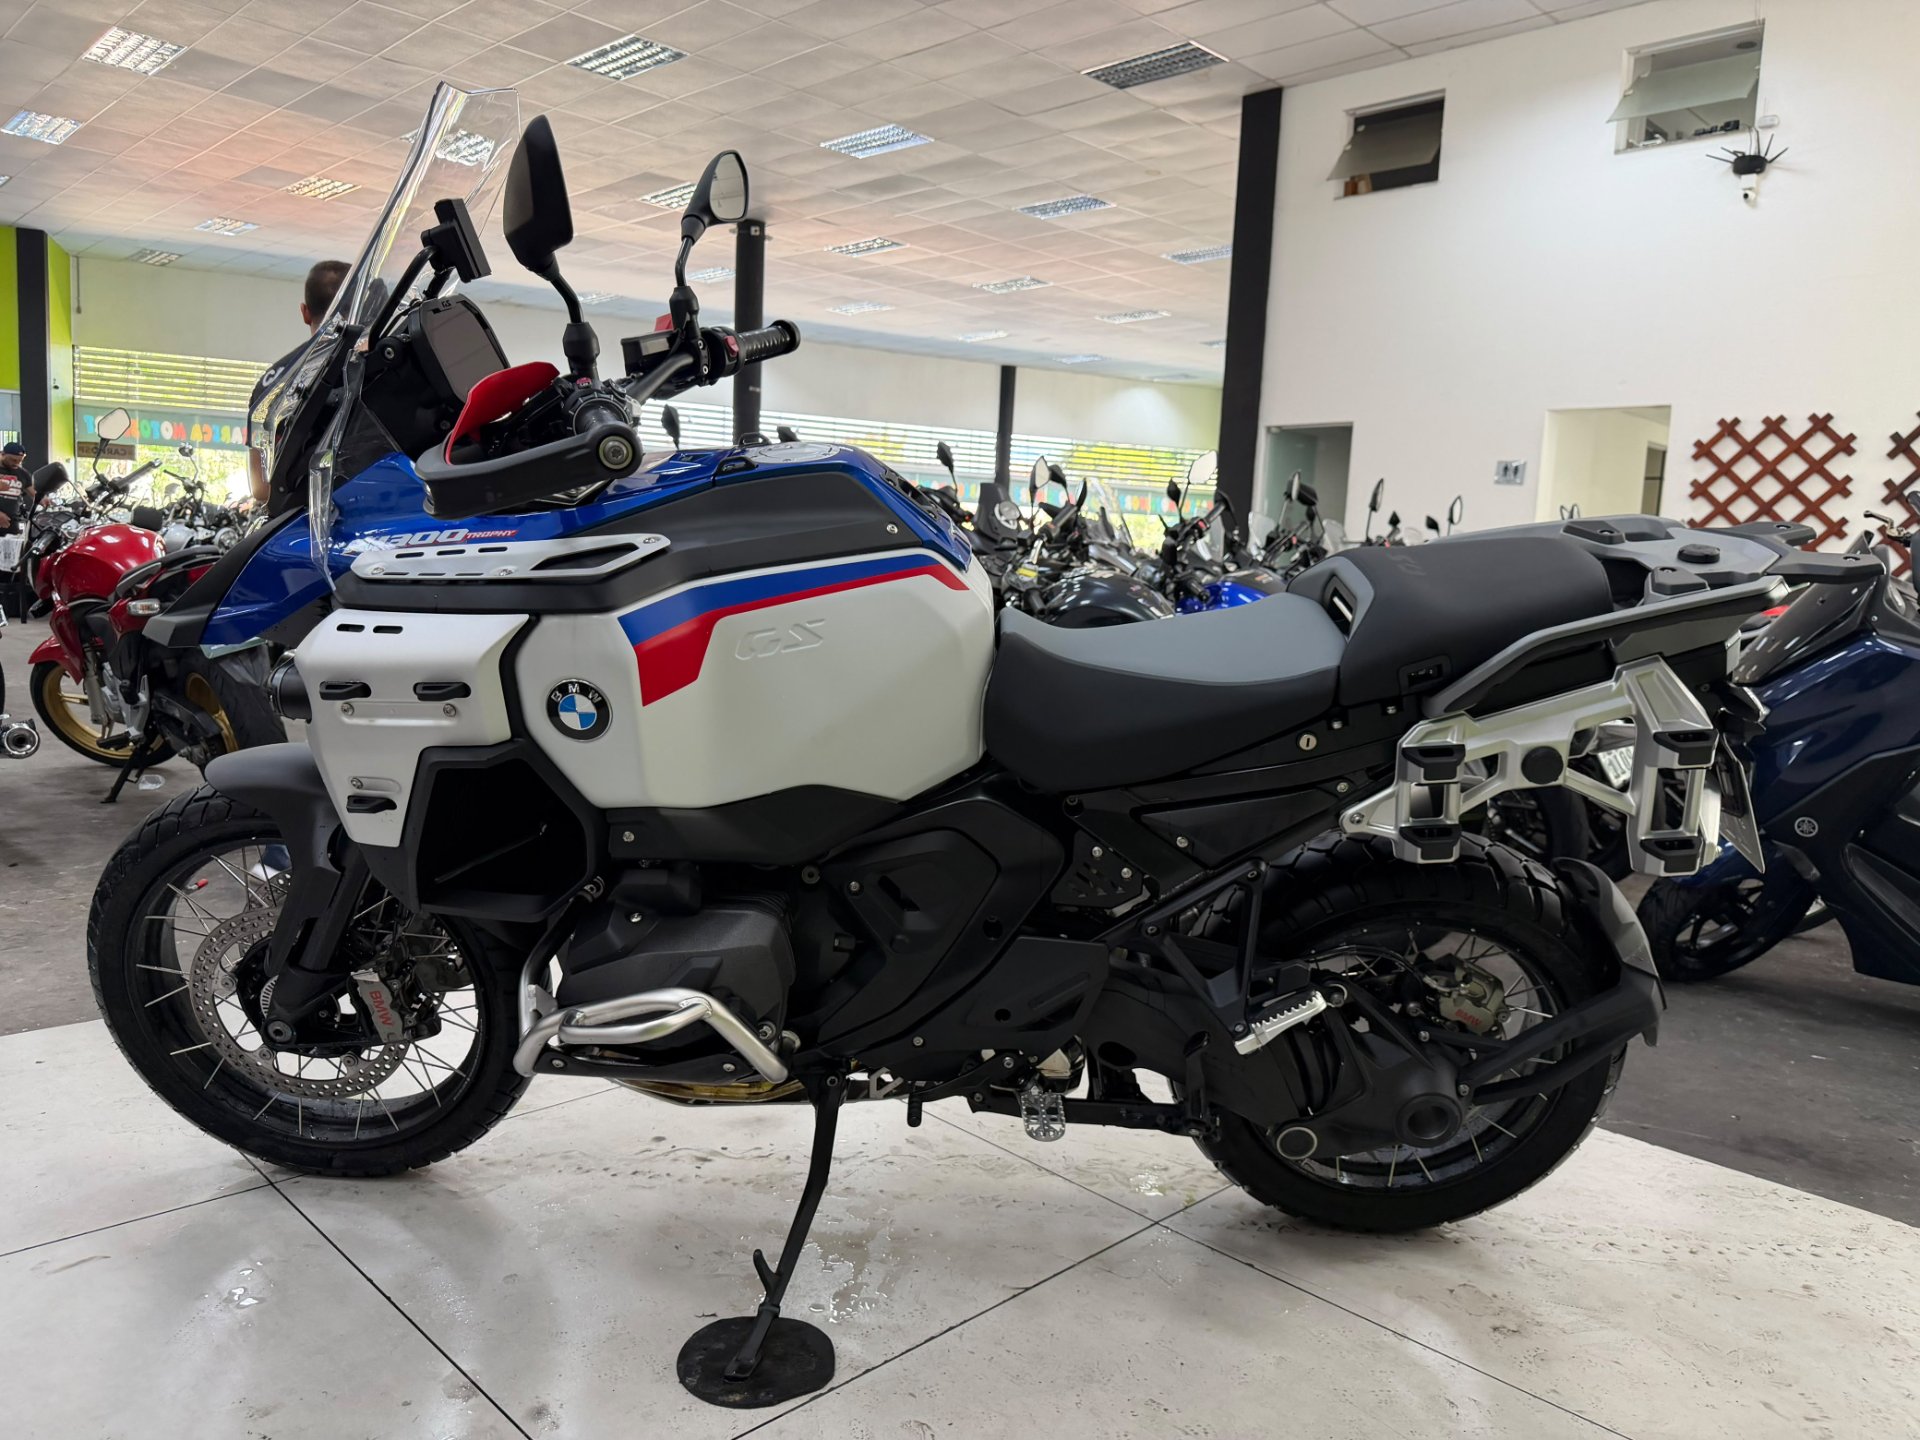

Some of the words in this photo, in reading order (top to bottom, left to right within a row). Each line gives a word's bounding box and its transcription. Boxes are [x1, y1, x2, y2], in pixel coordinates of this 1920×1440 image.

[465, 530, 516, 539] TROPHY
[735, 618, 825, 660] GS
[550, 683, 602, 703] BMW
[369, 990, 396, 1027] BMW
